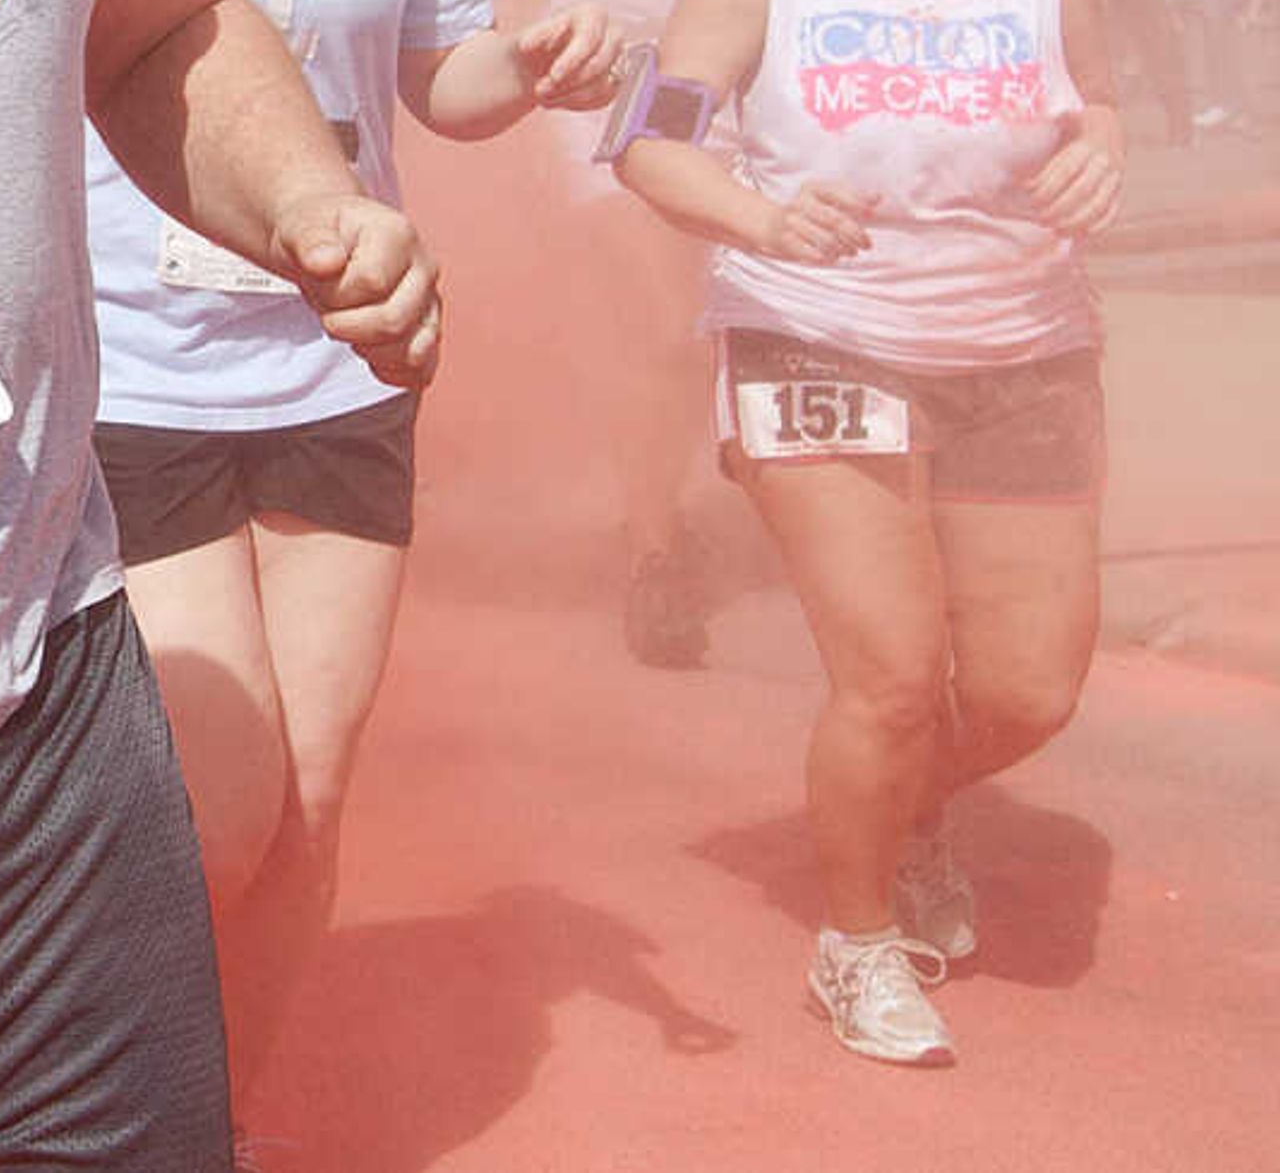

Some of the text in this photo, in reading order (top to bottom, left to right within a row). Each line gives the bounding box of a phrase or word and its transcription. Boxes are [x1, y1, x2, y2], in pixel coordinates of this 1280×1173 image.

[814, 16, 1022, 76] COLOR
[814, 73, 872, 114] ME
[773, 385, 869, 443] 151
